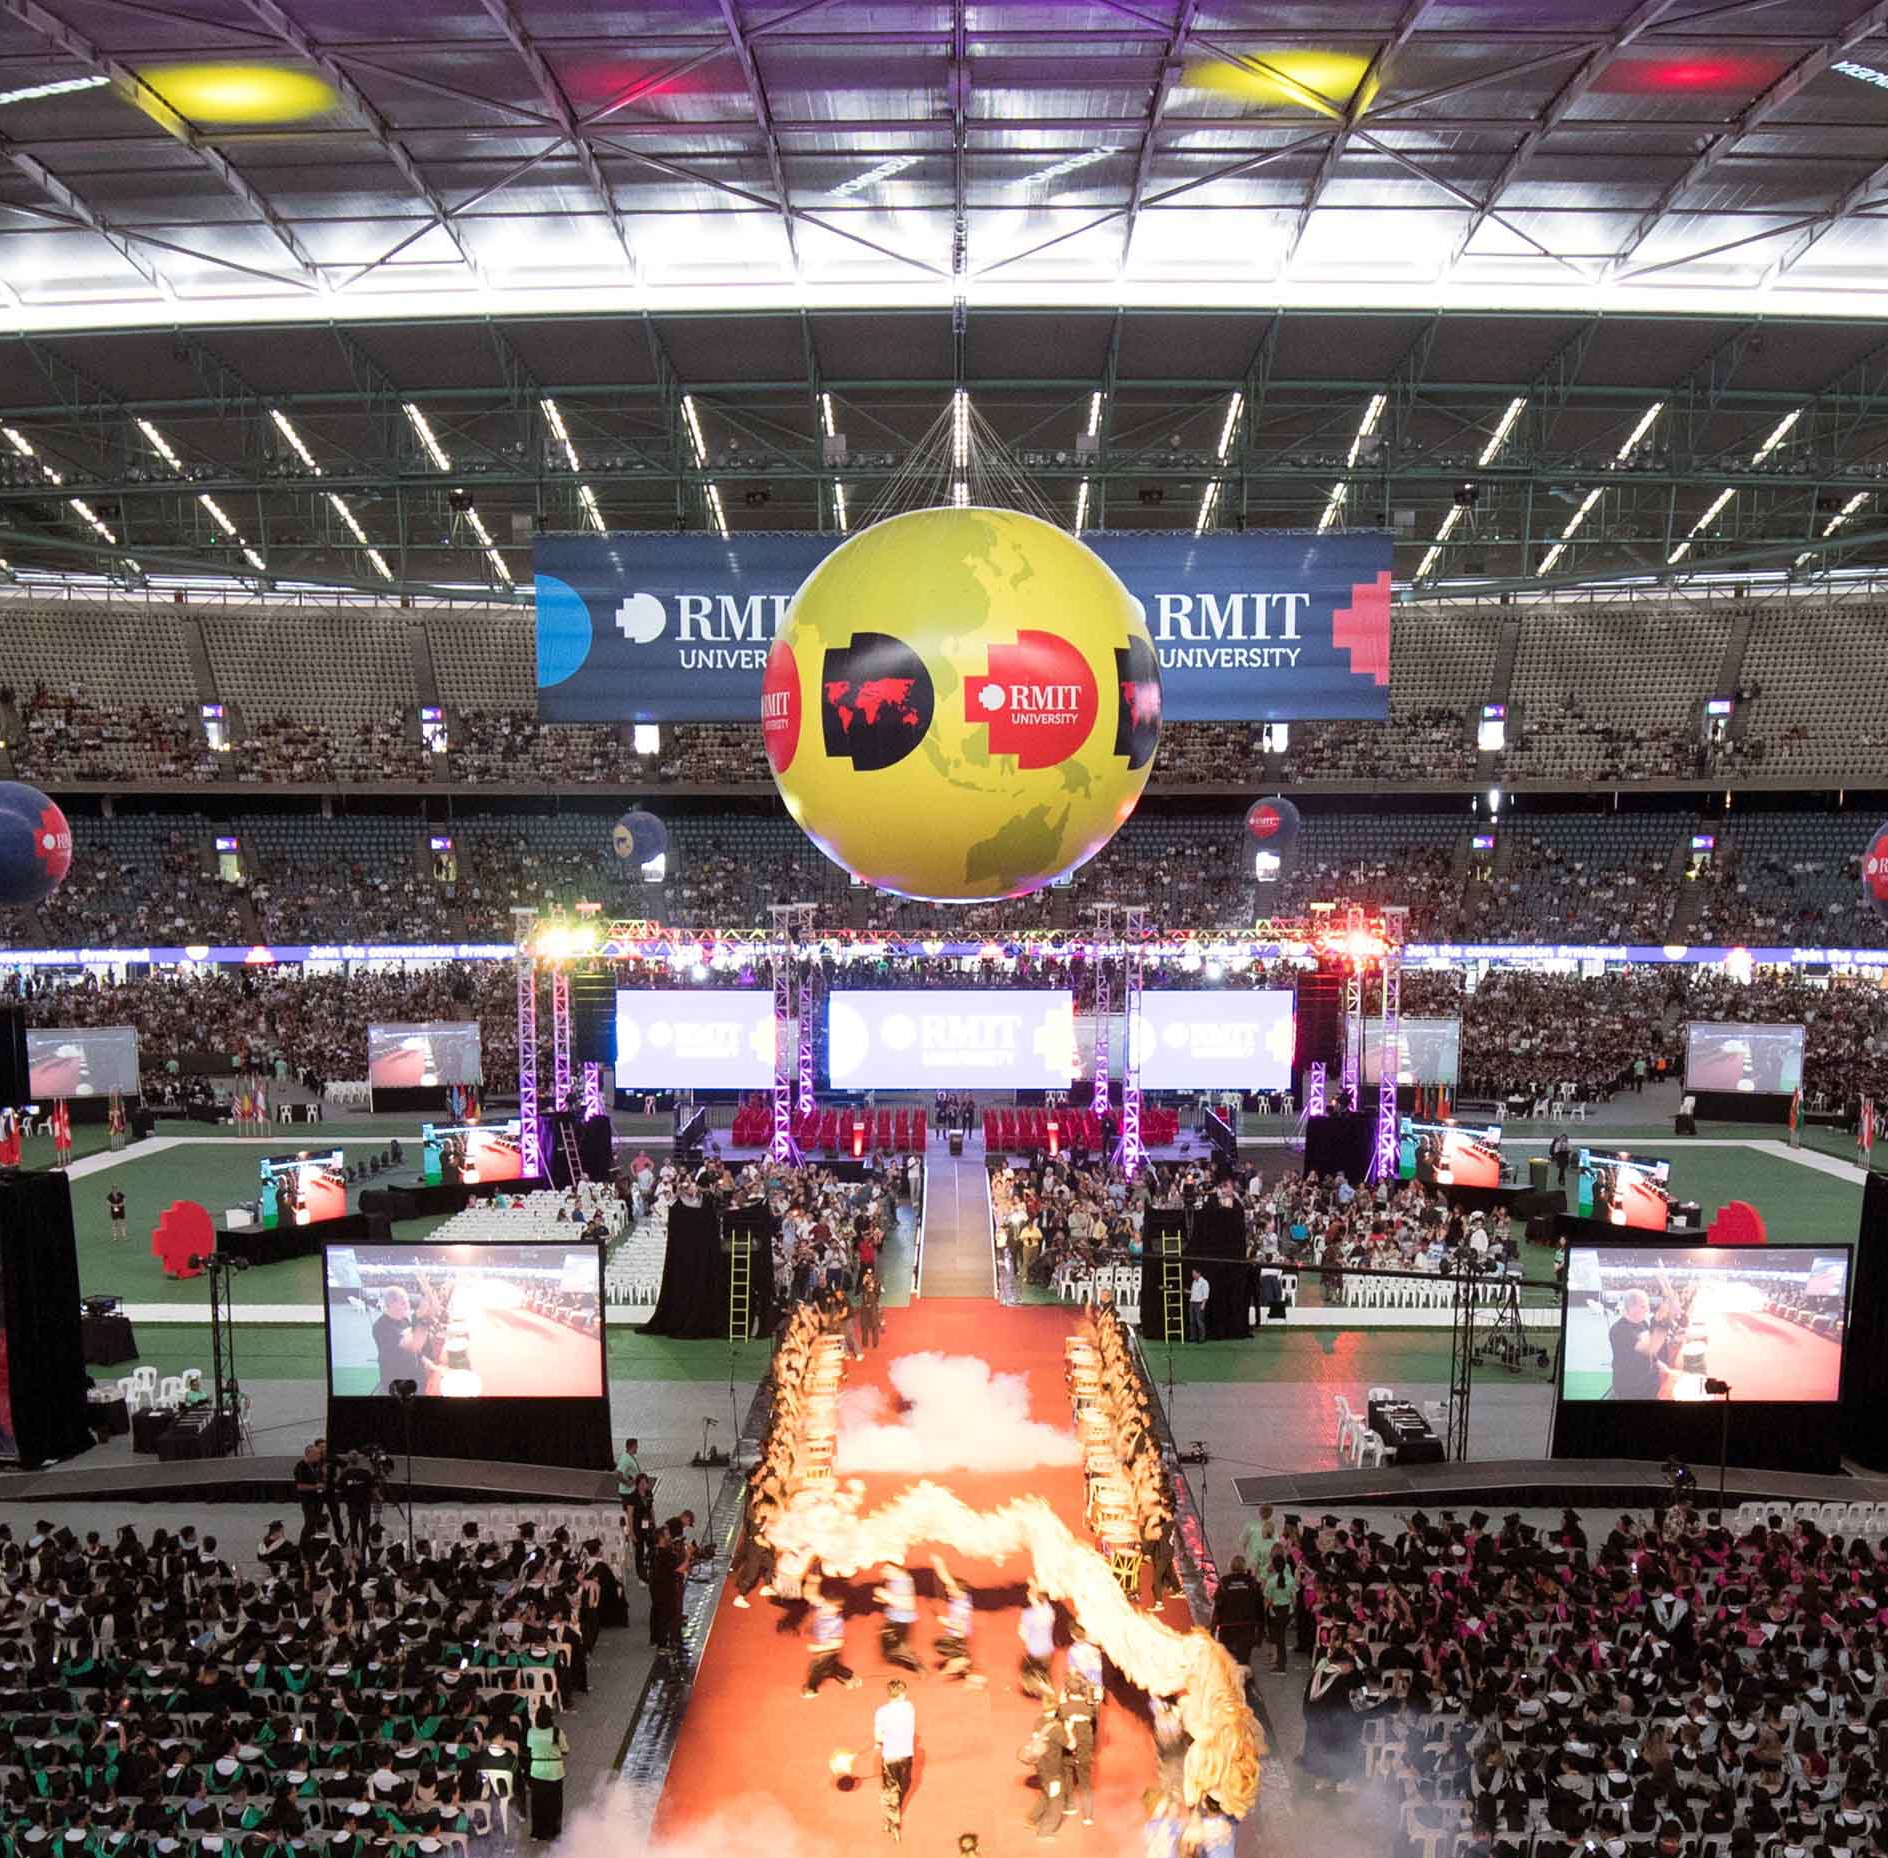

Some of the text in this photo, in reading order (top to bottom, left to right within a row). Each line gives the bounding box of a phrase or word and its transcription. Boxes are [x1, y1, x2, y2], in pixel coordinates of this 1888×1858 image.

[674, 594, 794, 642] RMI
[1154, 592, 1310, 641] RMIT
[680, 650, 767, 670] UNIVER
[1159, 647, 1301, 669] UNIVERSITY
[1009, 684, 1082, 711] RMIT
[1011, 713, 1079, 725] UNIVERSITY
[1406, 945, 1434, 958] Join
[1437, 945, 1460, 959] the
[1791, 949, 1823, 962] Join
[1826, 949, 1851, 963] the
[922, 1015, 1023, 1048] RMIT
